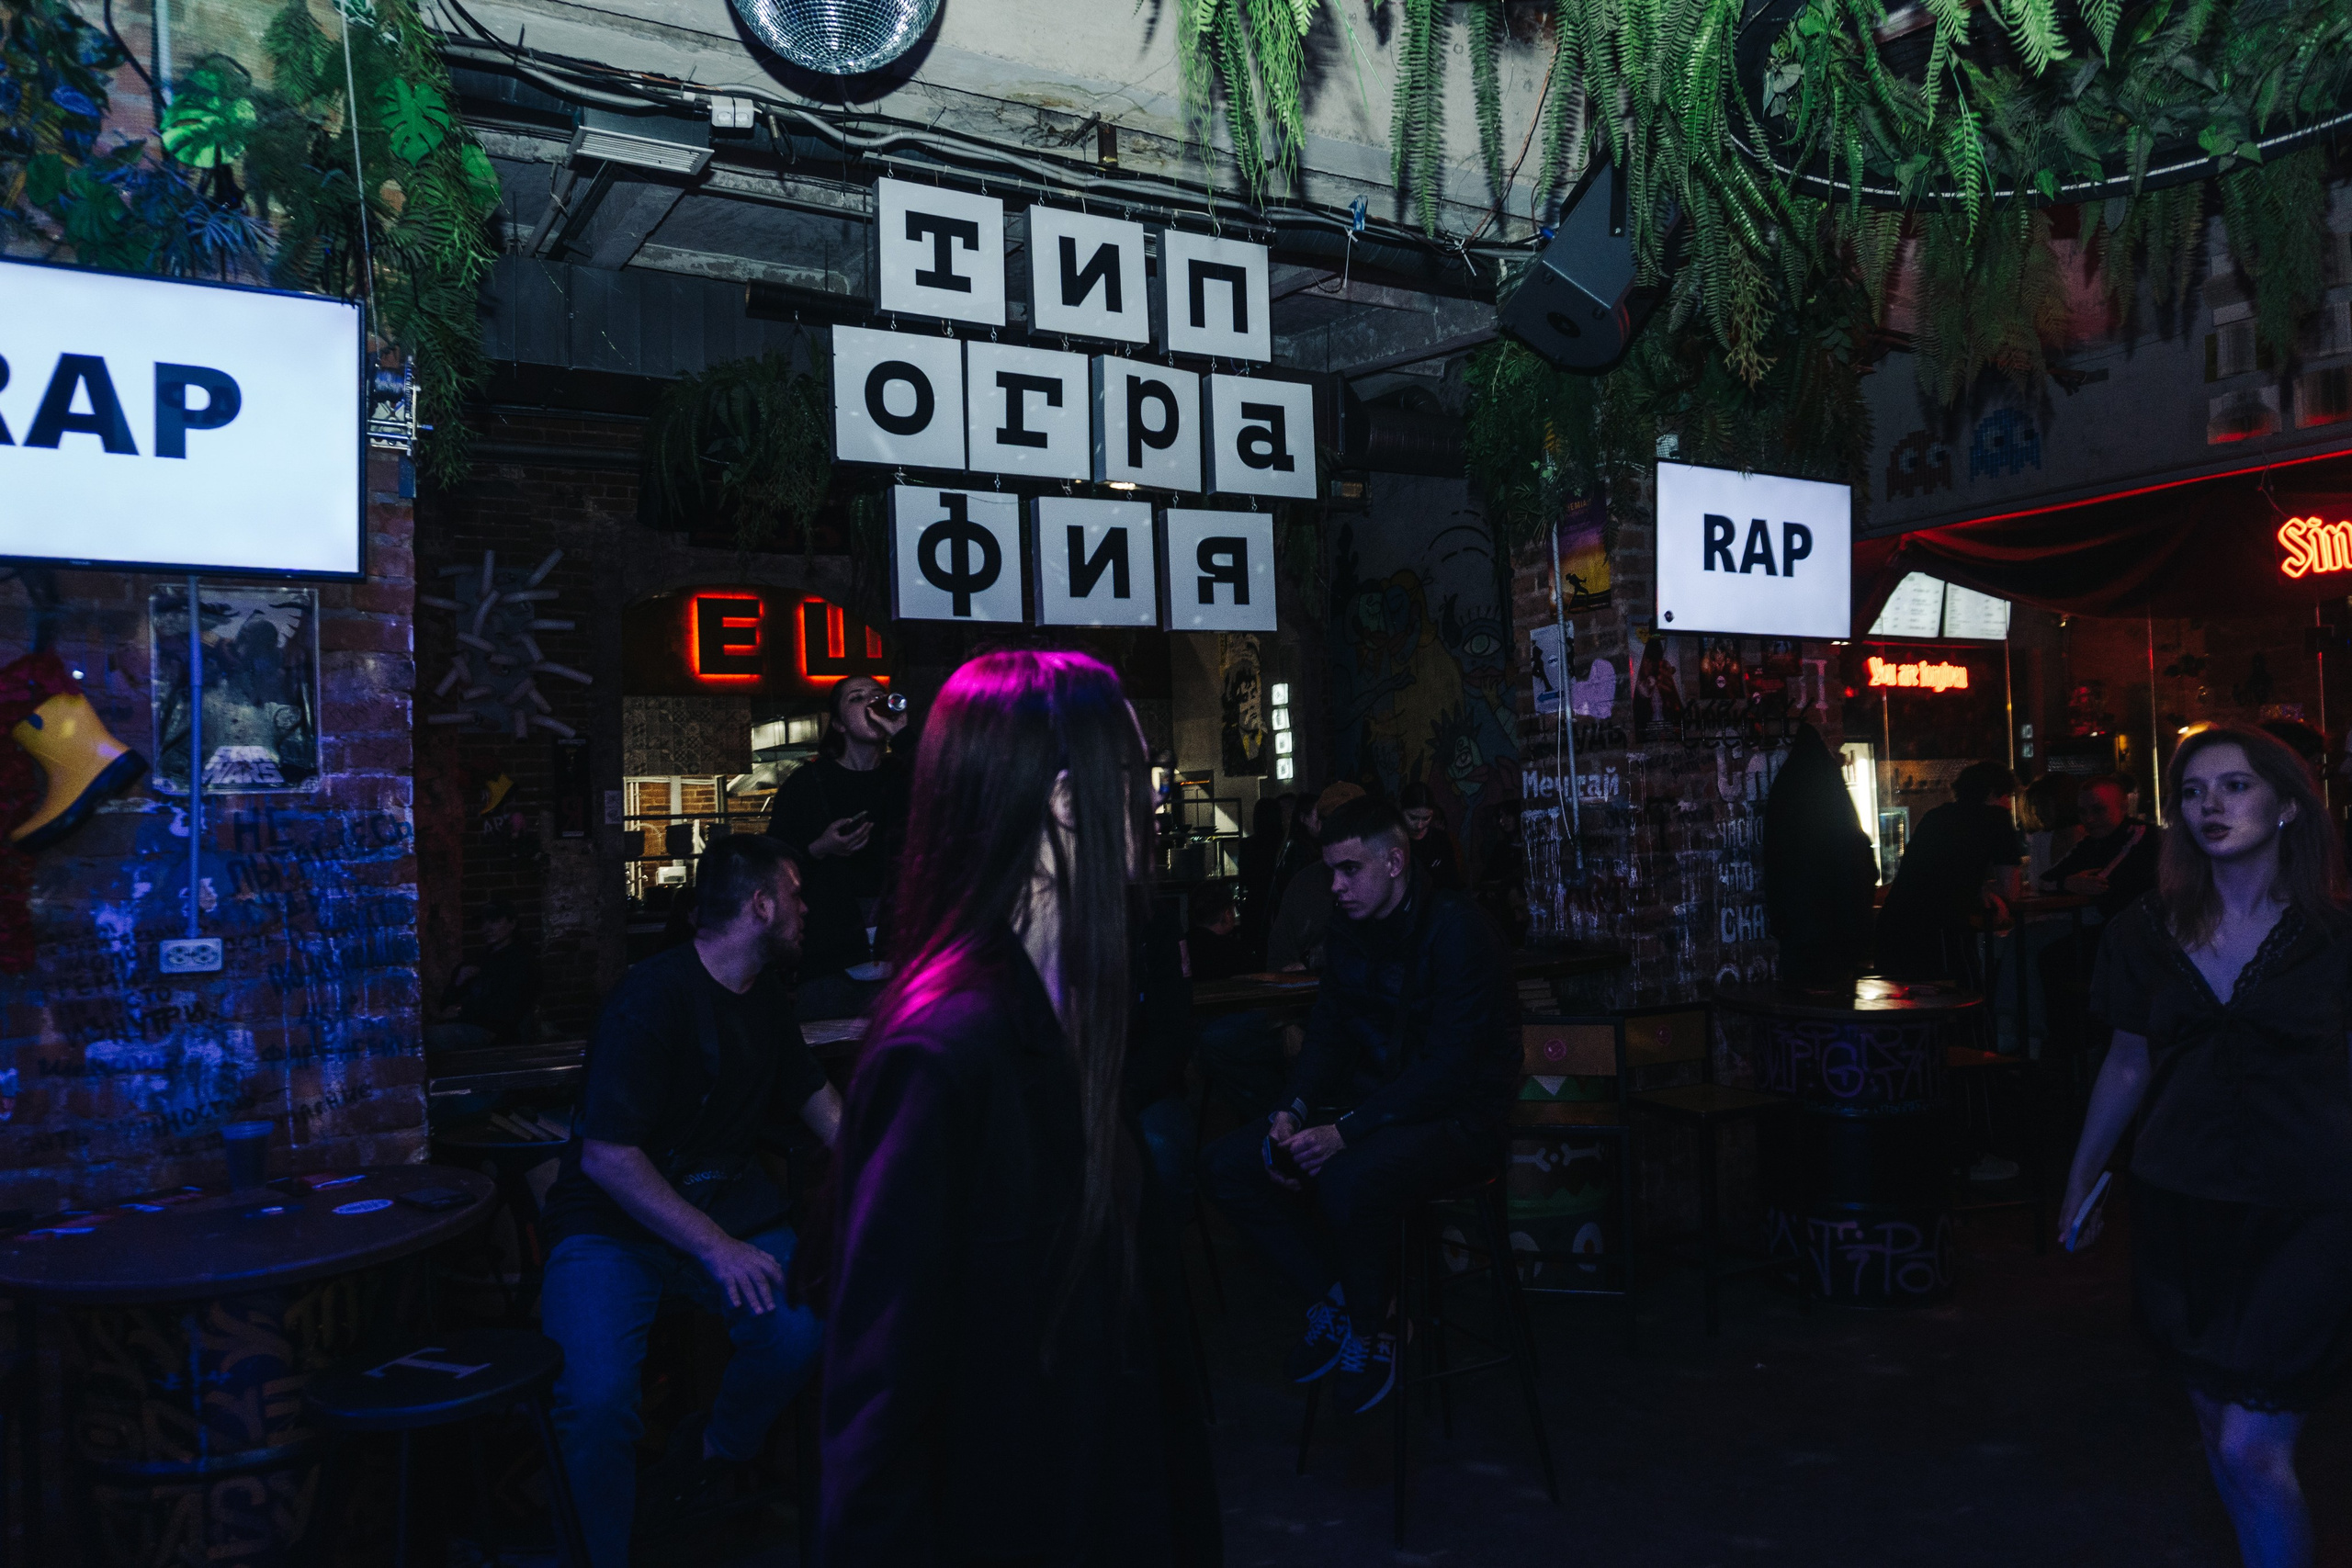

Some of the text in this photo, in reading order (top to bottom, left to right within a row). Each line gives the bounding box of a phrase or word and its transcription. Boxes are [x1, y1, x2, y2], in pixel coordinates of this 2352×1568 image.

[0, 352, 242, 459] AP
[1703, 513, 1813, 578] RAP
[1521, 766, 1621, 803] Мечтай
[235, 807, 294, 852] НЕ
[1718, 861, 1754, 892] ЧТО
